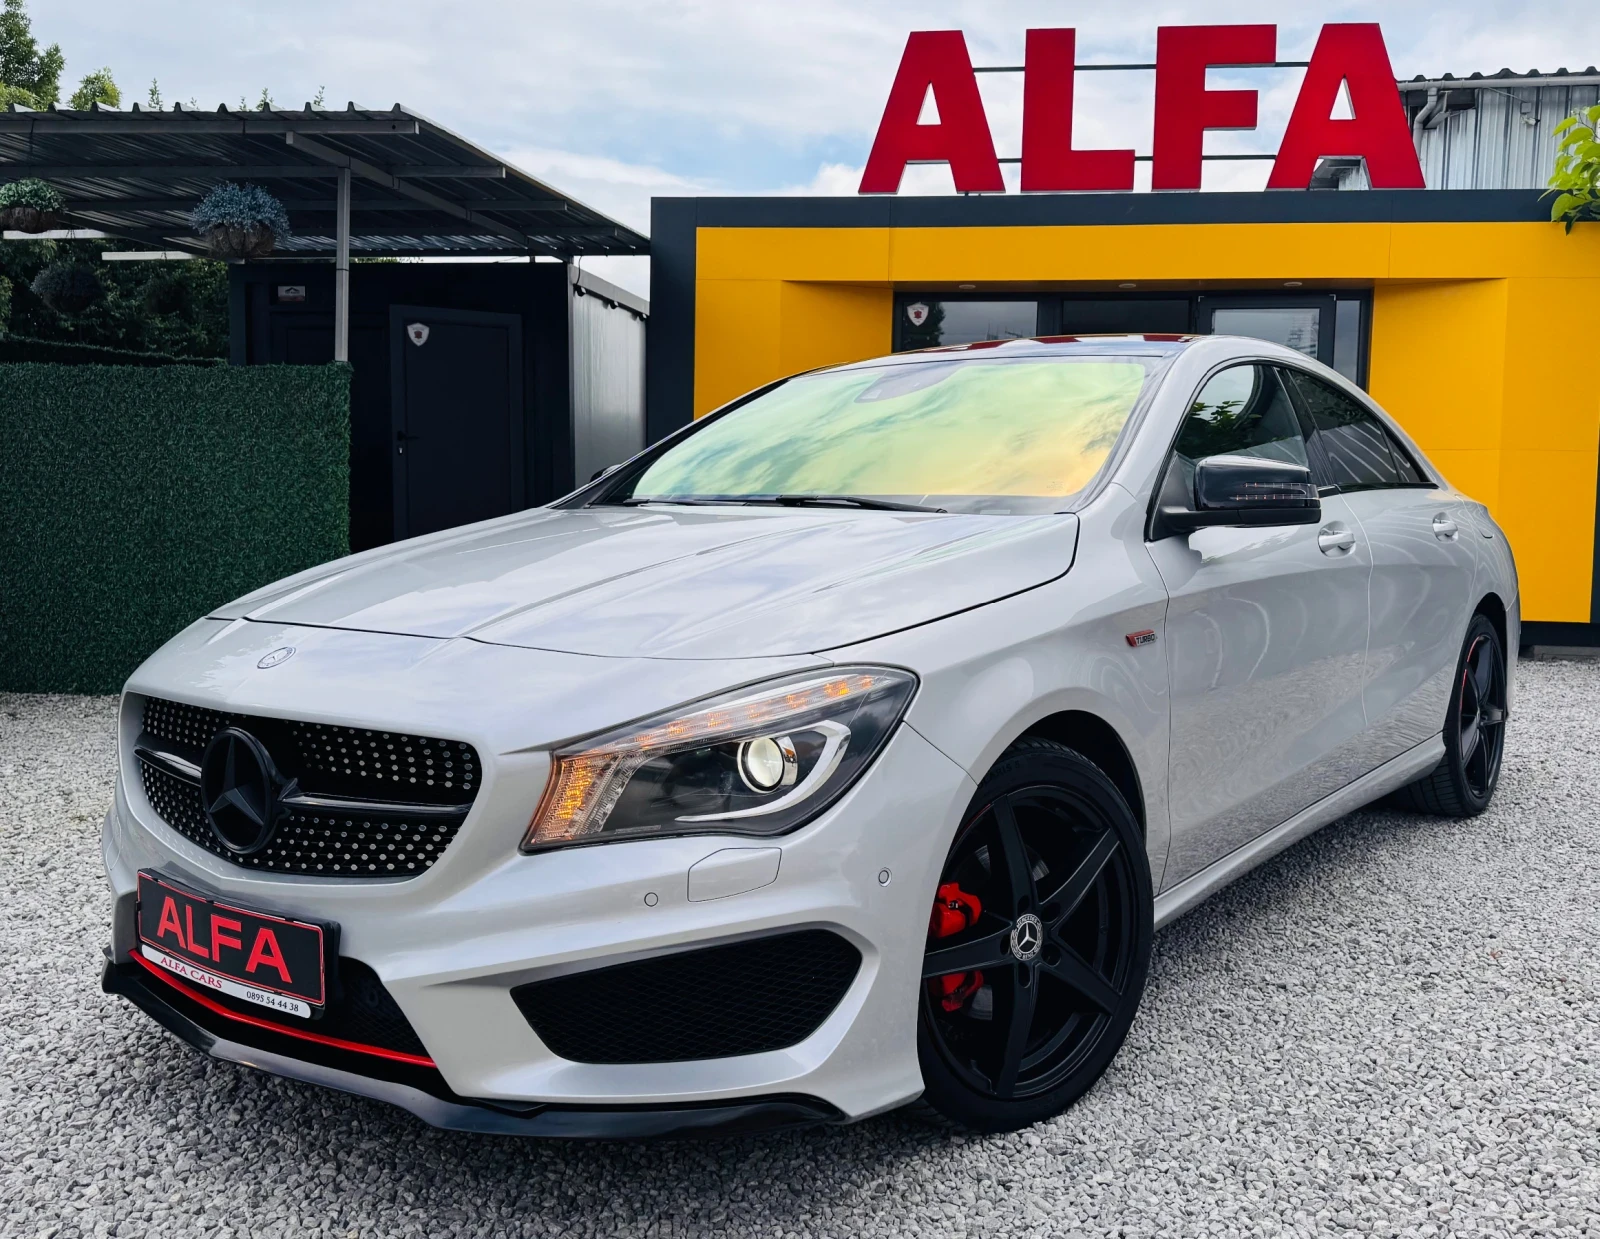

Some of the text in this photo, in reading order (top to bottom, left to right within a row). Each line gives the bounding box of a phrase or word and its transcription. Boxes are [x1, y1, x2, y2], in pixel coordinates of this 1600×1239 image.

[858, 23, 1426, 194] ALFA
[1136, 633, 1155, 645] TURBO
[157, 896, 292, 983] ALFA
[160, 956, 223, 989] ALFA CARS
[246, 990, 299, 1012] 0895 54 44 38
